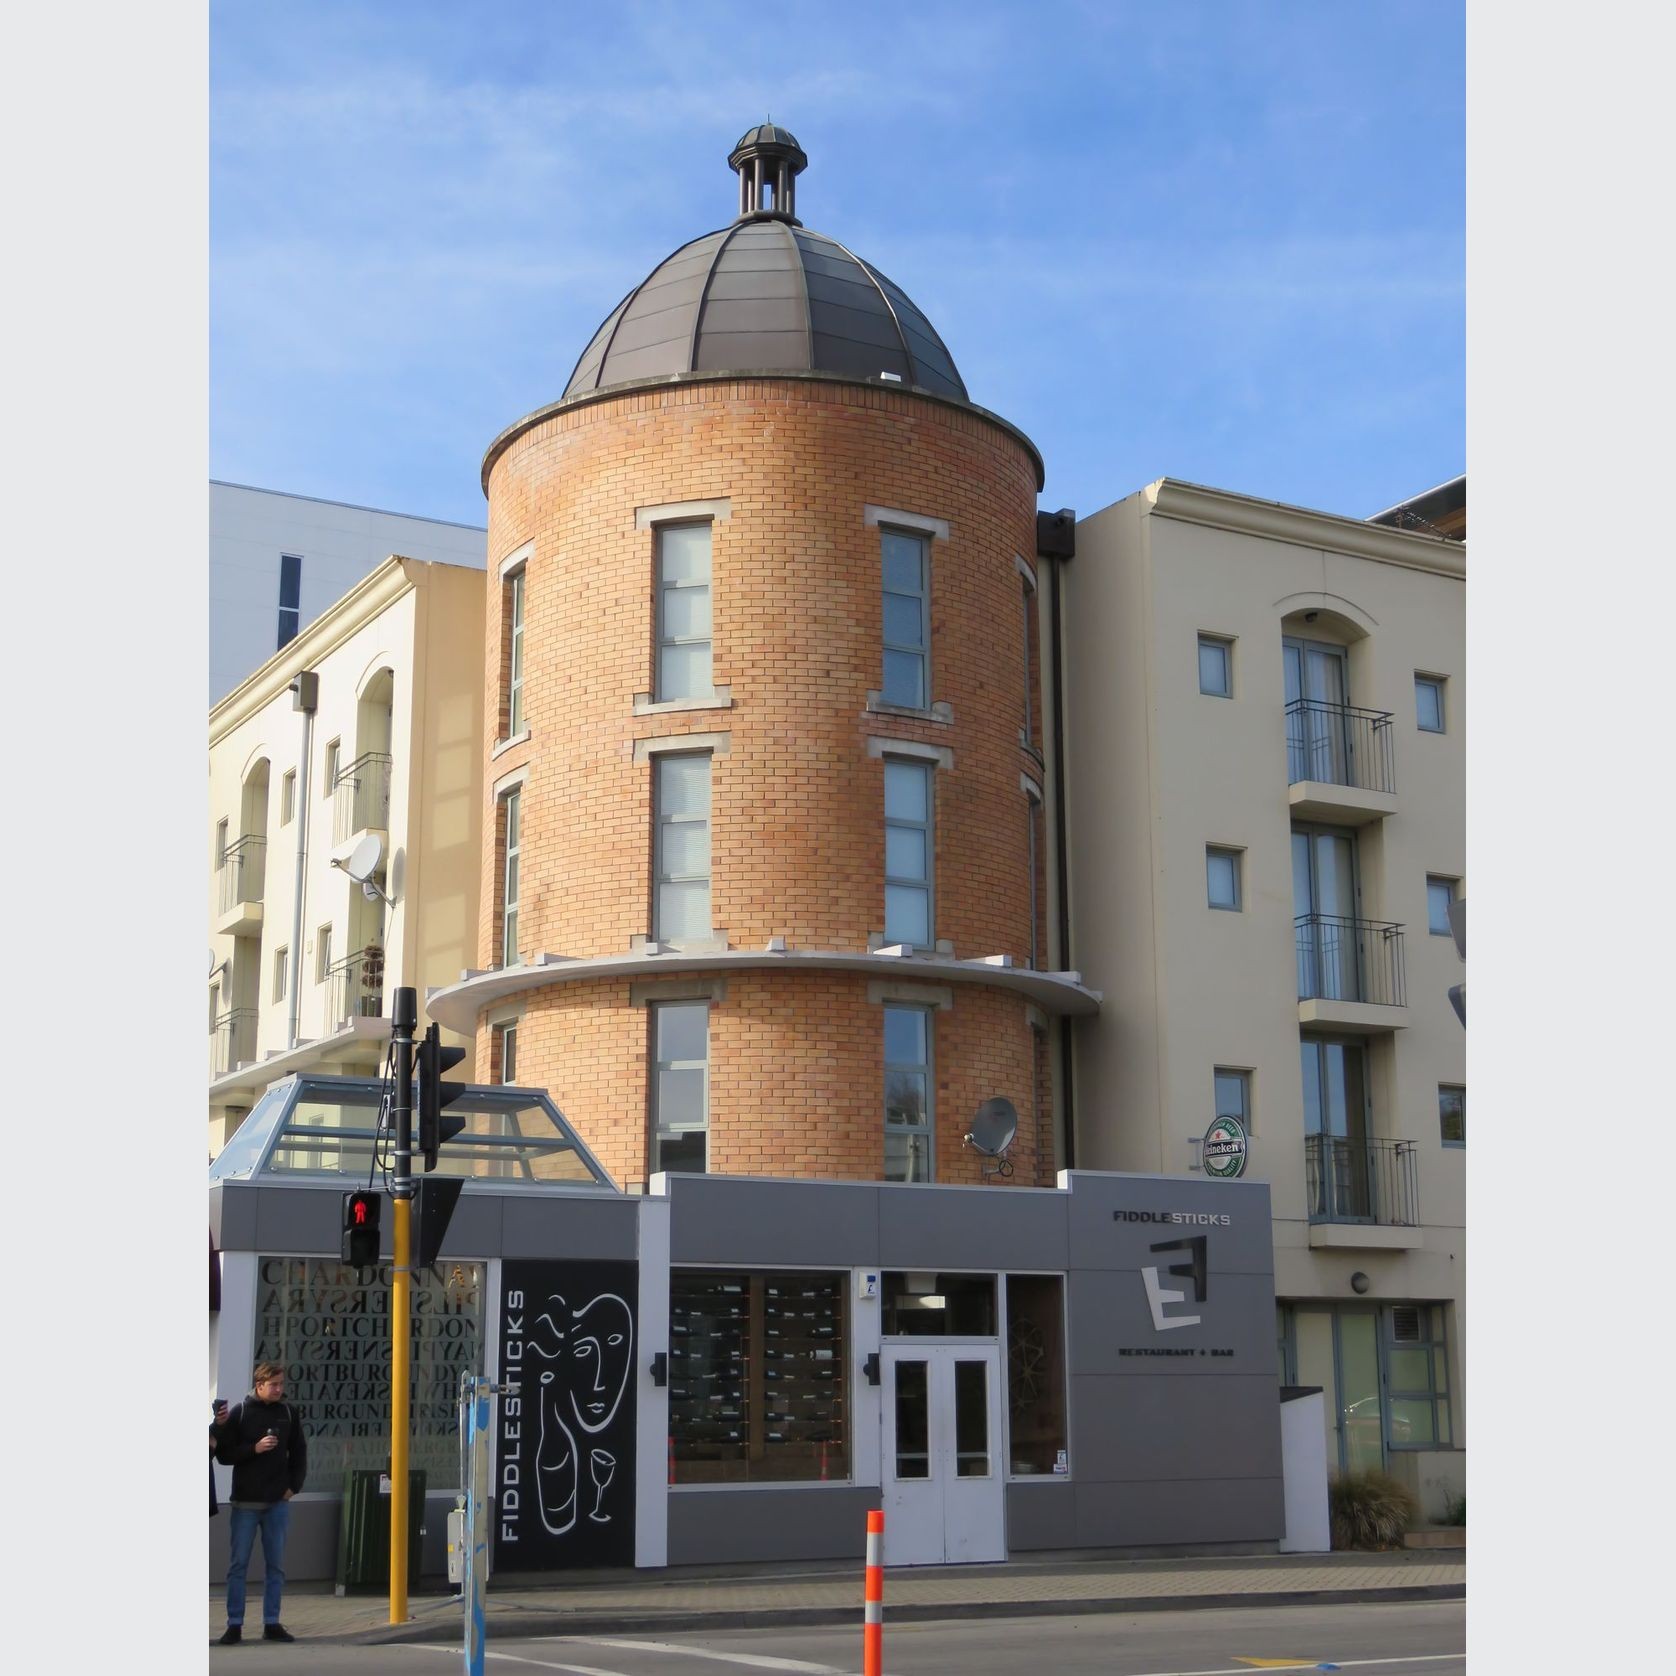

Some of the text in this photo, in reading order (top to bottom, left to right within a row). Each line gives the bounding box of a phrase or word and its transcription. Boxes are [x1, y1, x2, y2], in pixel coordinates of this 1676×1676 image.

[1113, 1211, 1231, 1225] FIDDLESTICKS
[1119, 1348, 1196, 1357] RESTAURANT
[1211, 1349, 1235, 1357] BAR
[502, 1290, 524, 1541] FIDDLESTICKS
